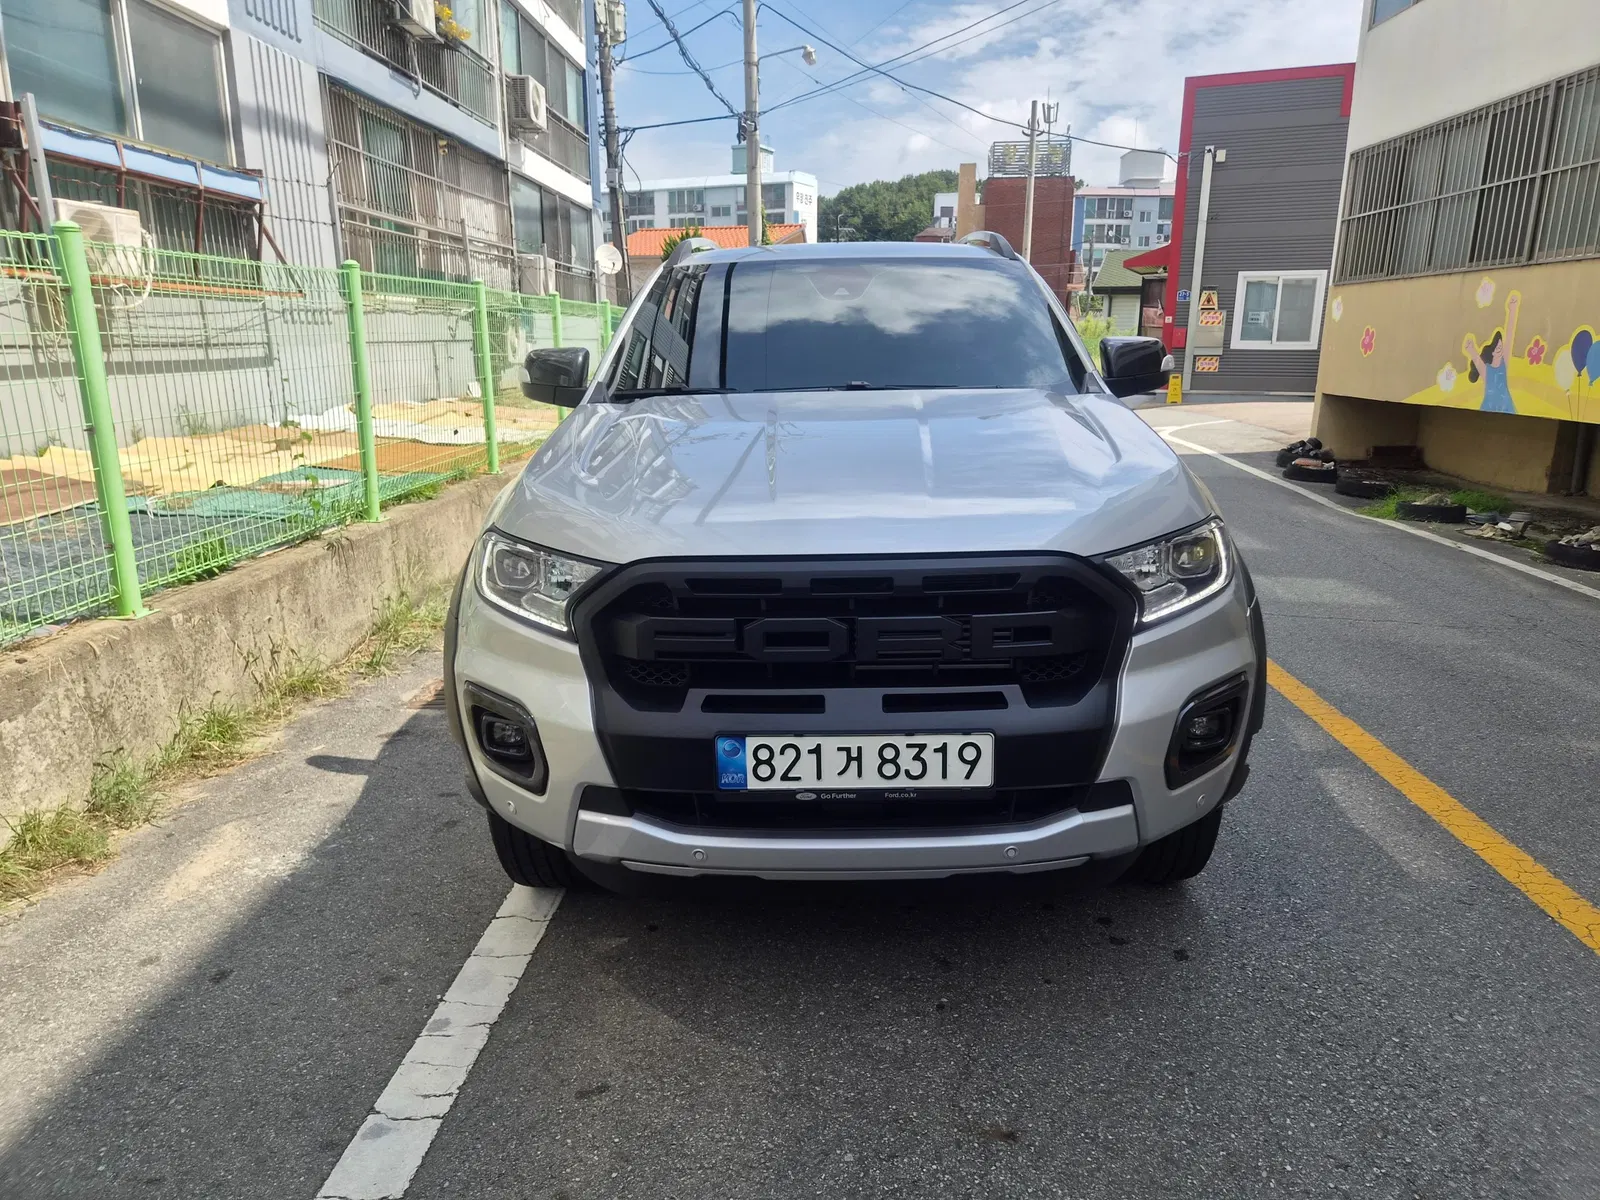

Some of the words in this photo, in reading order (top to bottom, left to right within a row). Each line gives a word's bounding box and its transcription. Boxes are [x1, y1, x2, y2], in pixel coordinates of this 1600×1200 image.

[634, 610, 1066, 662] FORD
[876, 741, 983, 781] 8319
[721, 773, 745, 784] KOR
[831, 792, 857, 800] Further
